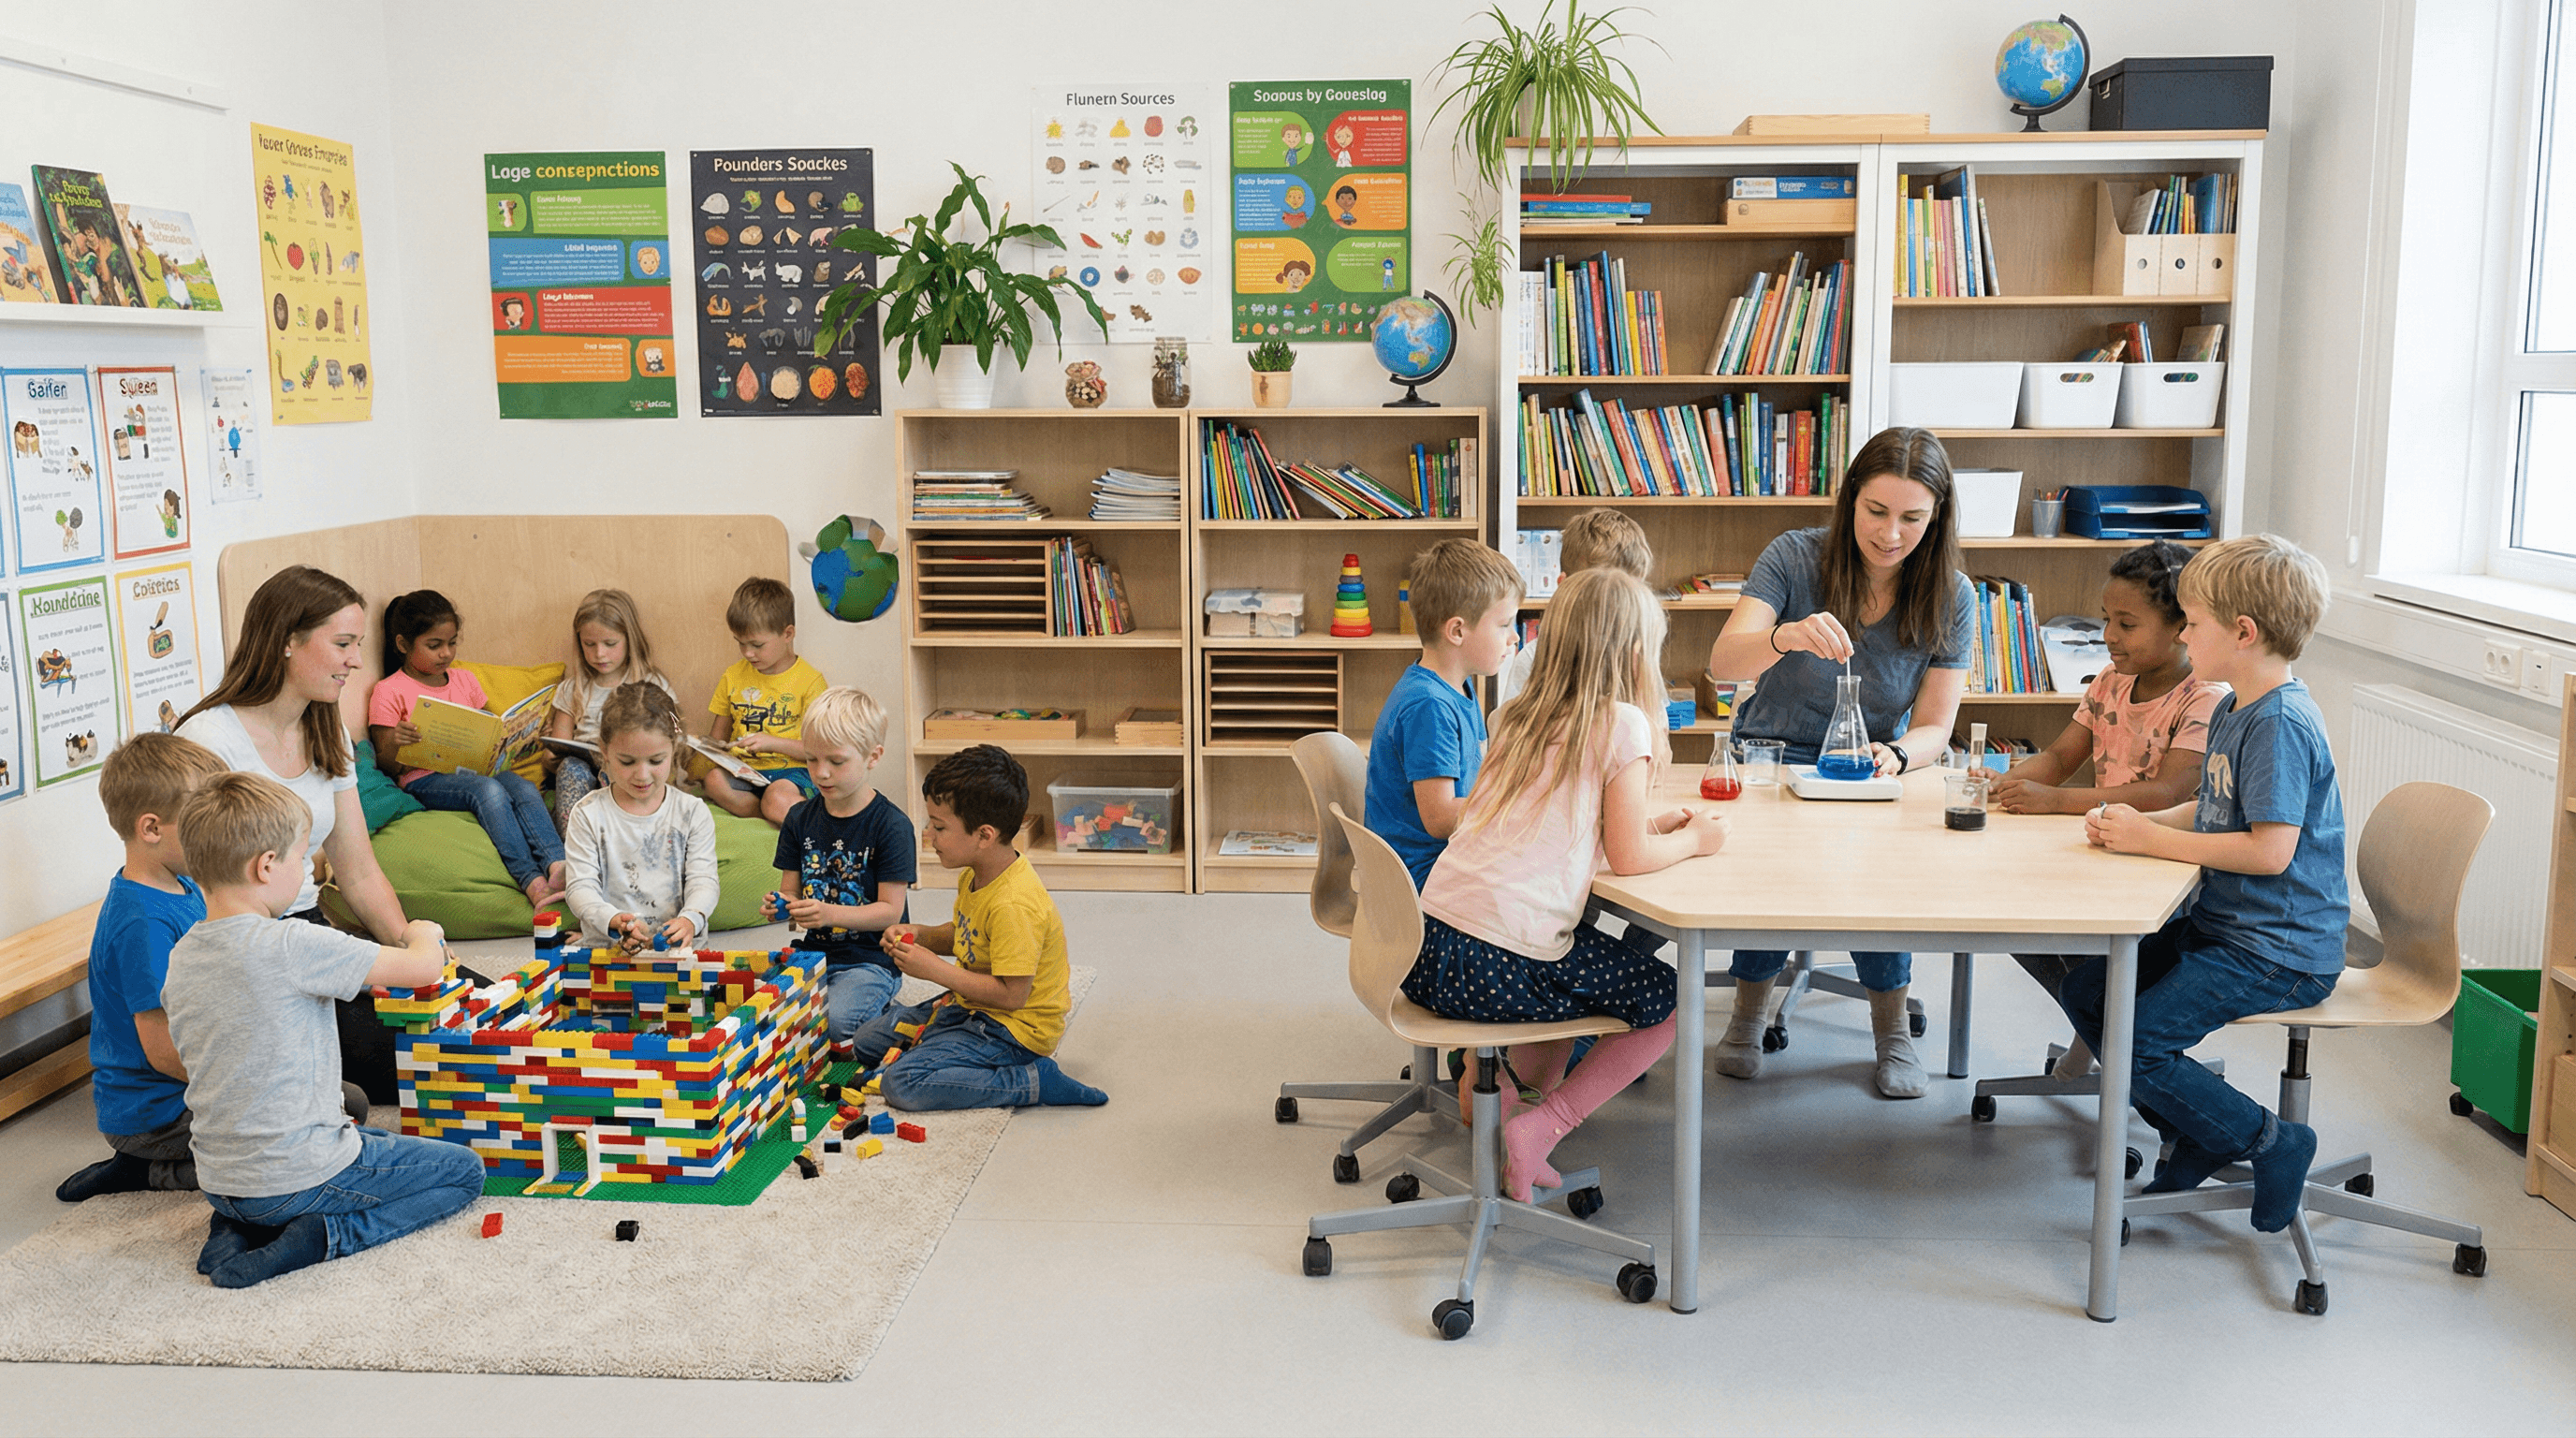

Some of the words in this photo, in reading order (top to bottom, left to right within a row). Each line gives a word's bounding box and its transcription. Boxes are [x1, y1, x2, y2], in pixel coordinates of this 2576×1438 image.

[1120, 92, 1176, 105] Sources
[1253, 89, 1303, 102] Soapus
[1306, 88, 1323, 104] by
[713, 156, 783, 172] Pounders
[787, 155, 848, 171] Soackes
[491, 164, 531, 183] Lage
